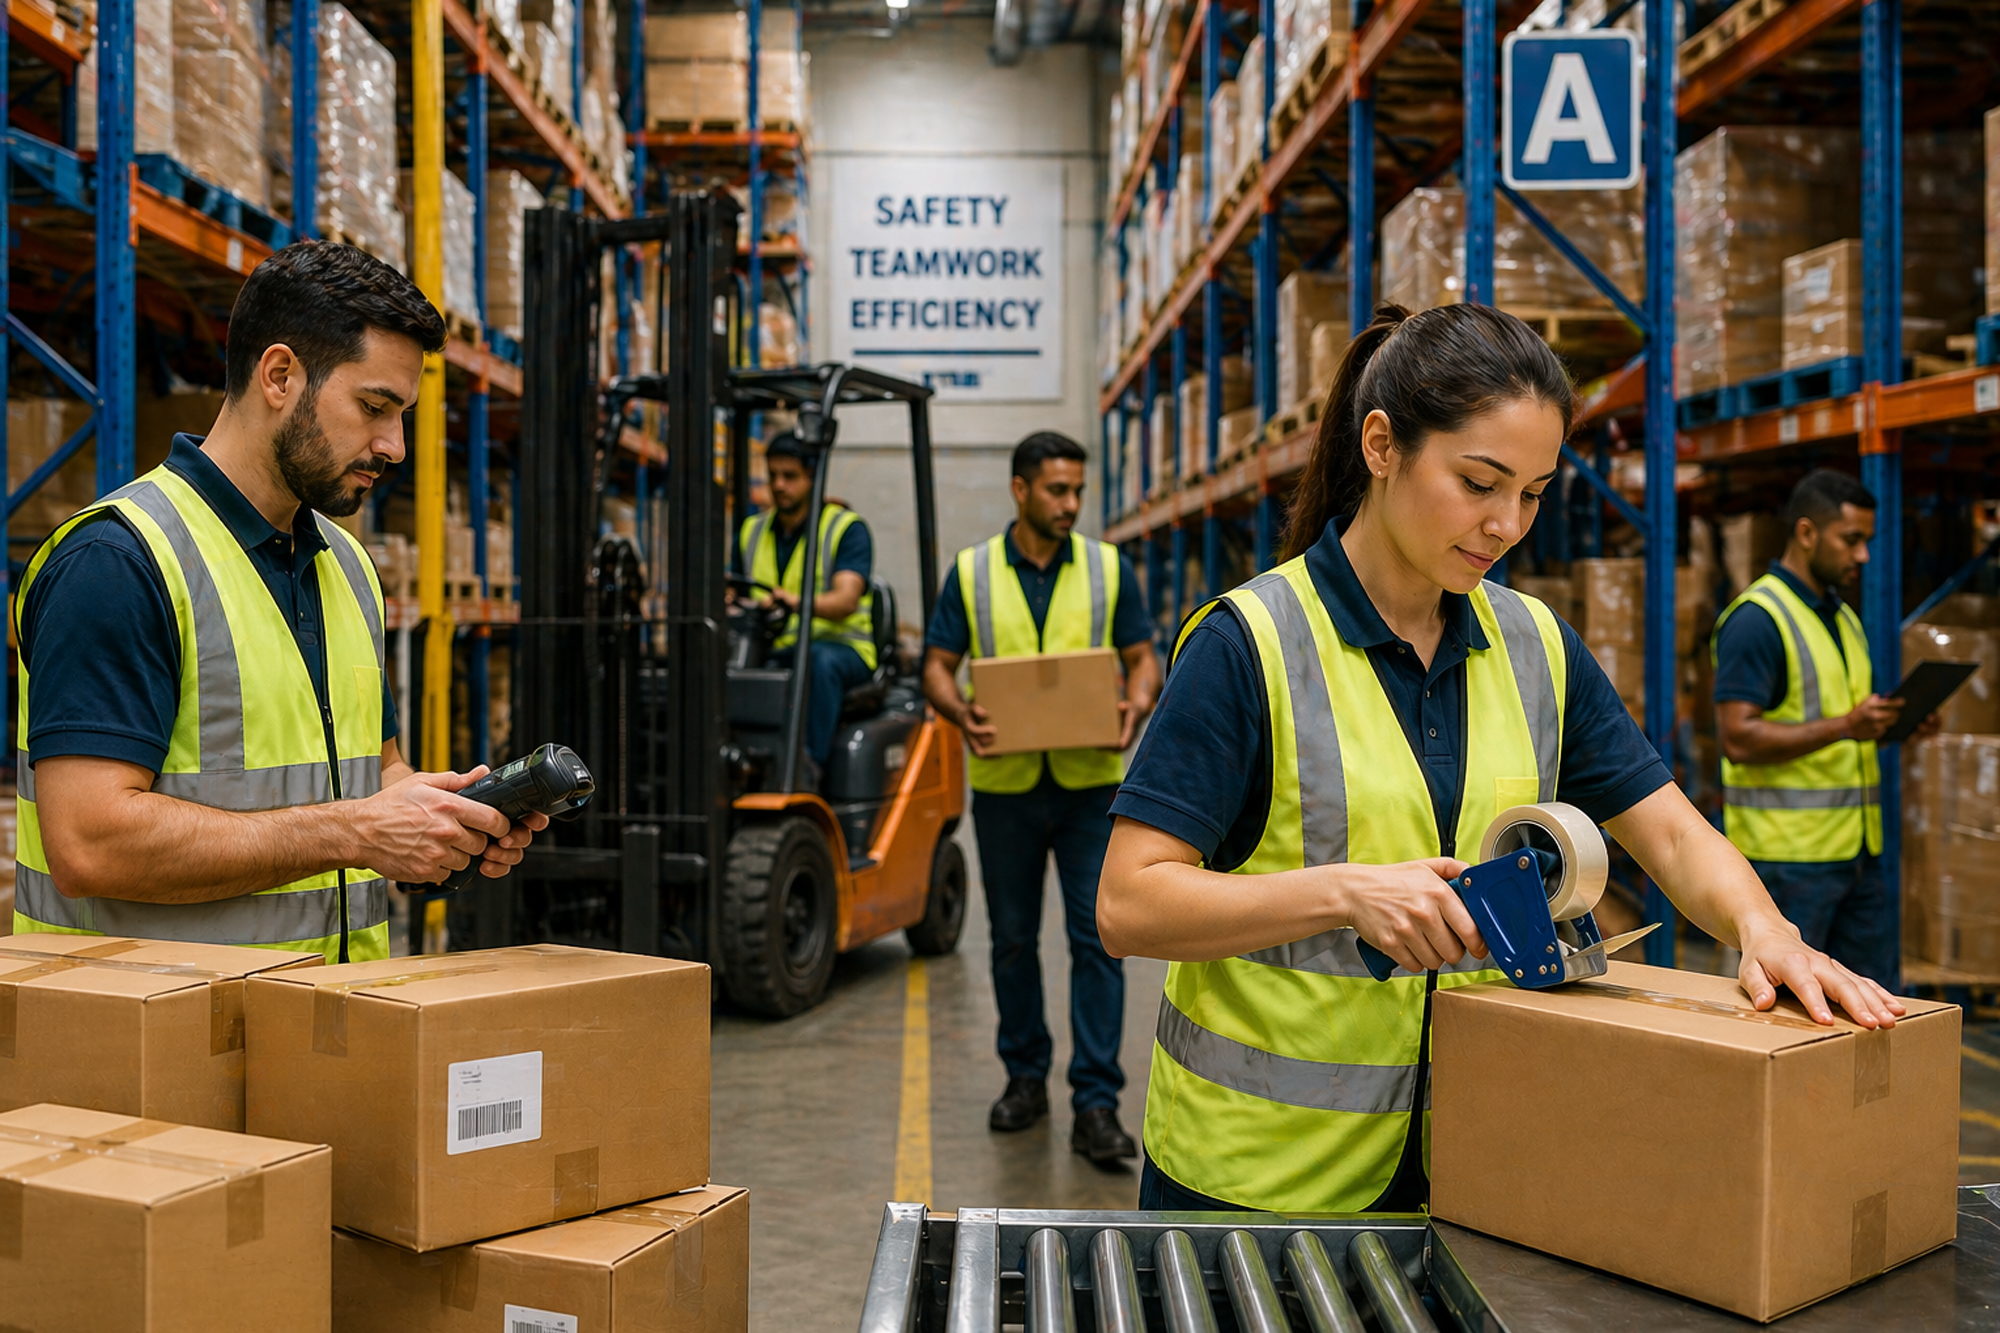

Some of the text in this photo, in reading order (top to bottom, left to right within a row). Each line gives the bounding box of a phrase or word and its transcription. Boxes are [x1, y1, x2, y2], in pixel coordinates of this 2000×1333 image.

[1521, 52, 1618, 164] A
[875, 196, 1008, 226] SAFETY
[849, 249, 1043, 278] TEAMWORK
[851, 300, 1042, 330] EFFICIENCY
